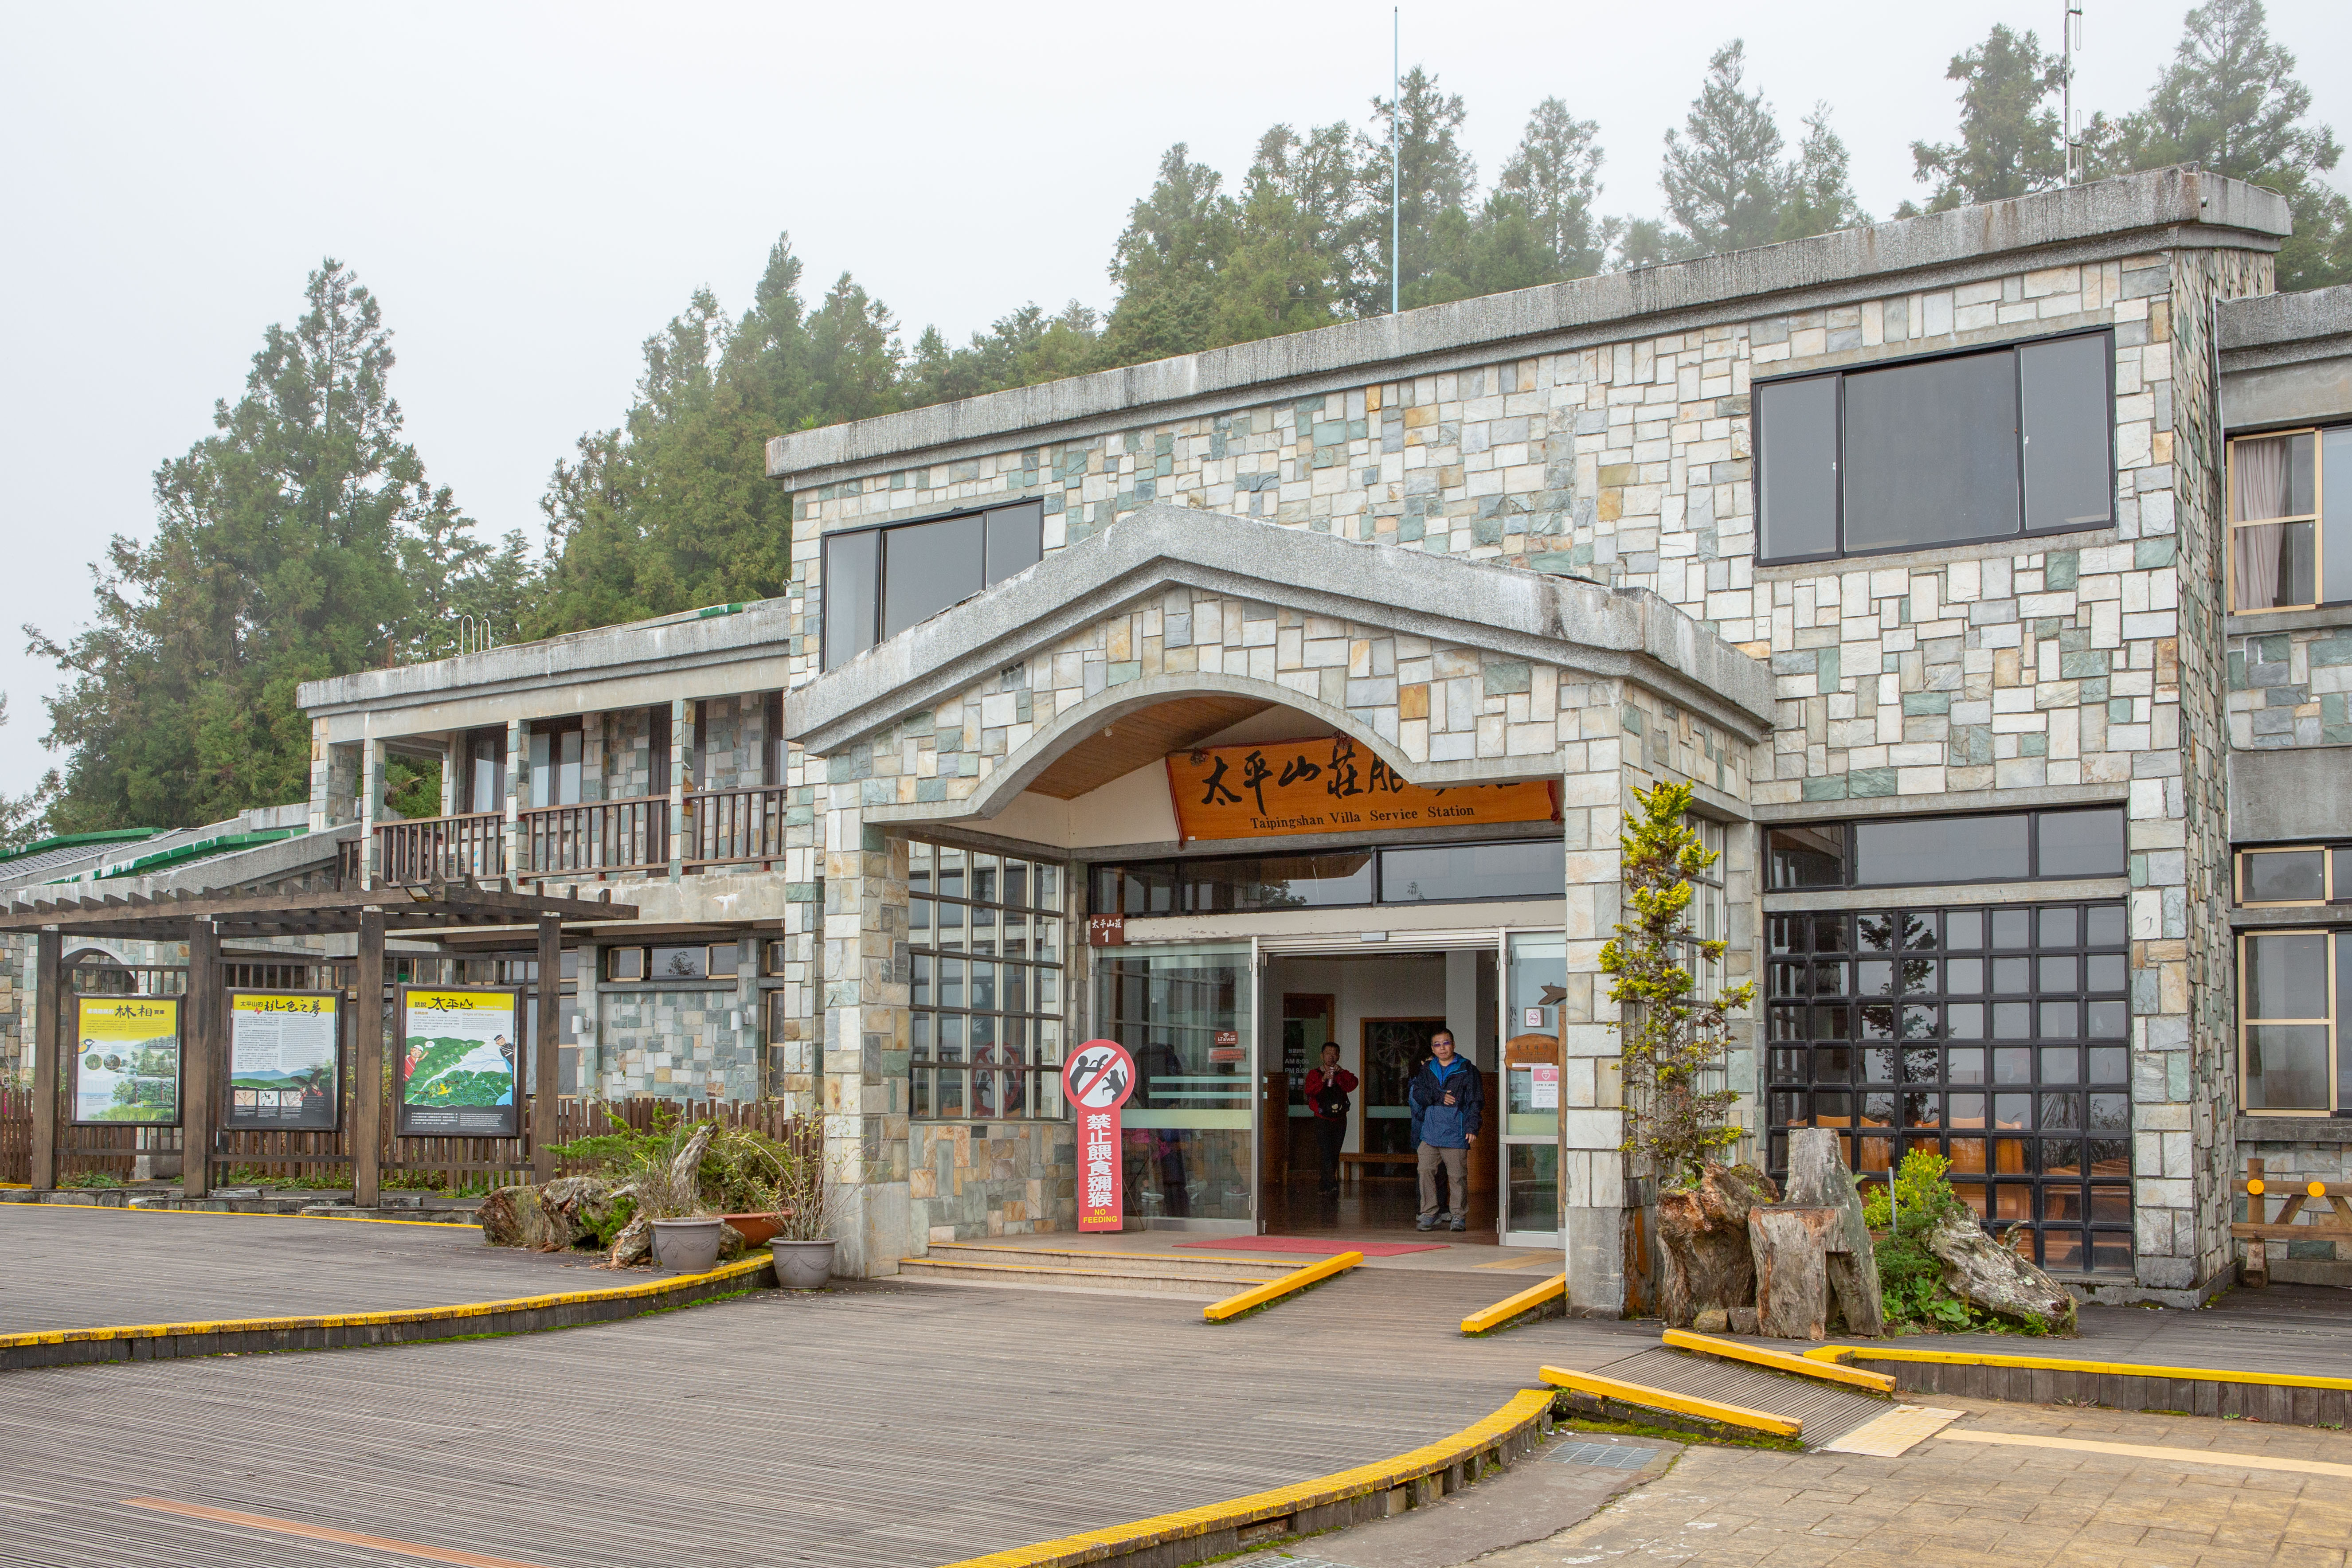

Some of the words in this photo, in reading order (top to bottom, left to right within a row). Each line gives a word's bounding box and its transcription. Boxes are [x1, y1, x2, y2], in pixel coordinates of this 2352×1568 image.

[1201, 745, 1521, 815] 太平山莊服
[1250, 815, 1324, 830] Taipingshan
[1330, 812, 1361, 823] Villa
[1370, 809, 1418, 821] Service
[1428, 805, 1475, 817] Station
[1092, 919, 1122, 929] 太平山莊
[1102, 930, 1109, 942] 1
[115, 1005, 153, 1019] 林相
[428, 997, 473, 1013] 太平山
[1087, 1113, 1113, 1208] 禁止餵食獼猴
